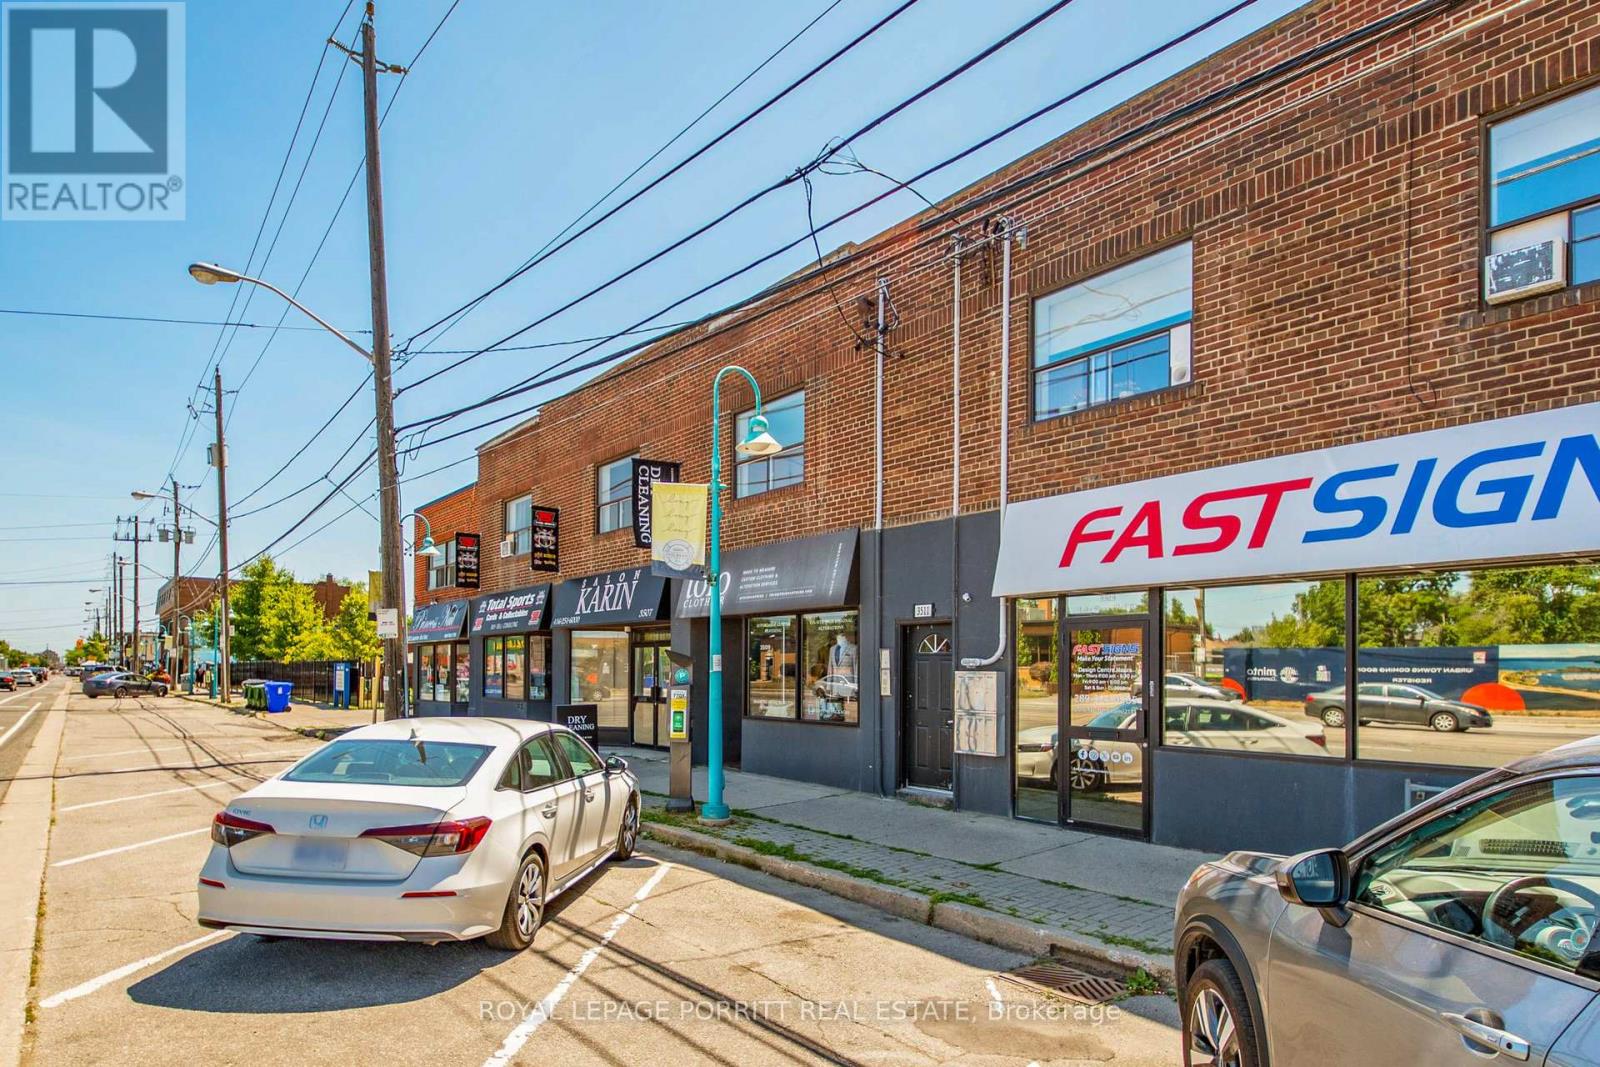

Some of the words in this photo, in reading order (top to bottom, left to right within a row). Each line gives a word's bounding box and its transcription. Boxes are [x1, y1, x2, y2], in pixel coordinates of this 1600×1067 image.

[638, 465, 652, 544] CLEANING
[582, 569, 642, 588] SALON
[486, 597, 508, 611] Total
[506, 593, 536, 610] Sports
[574, 580, 639, 615] KARIN
[683, 596, 725, 609] CLOTHR
[1072, 643, 1139, 655] FASTSIGNS
[567, 715, 587, 724] DRY
